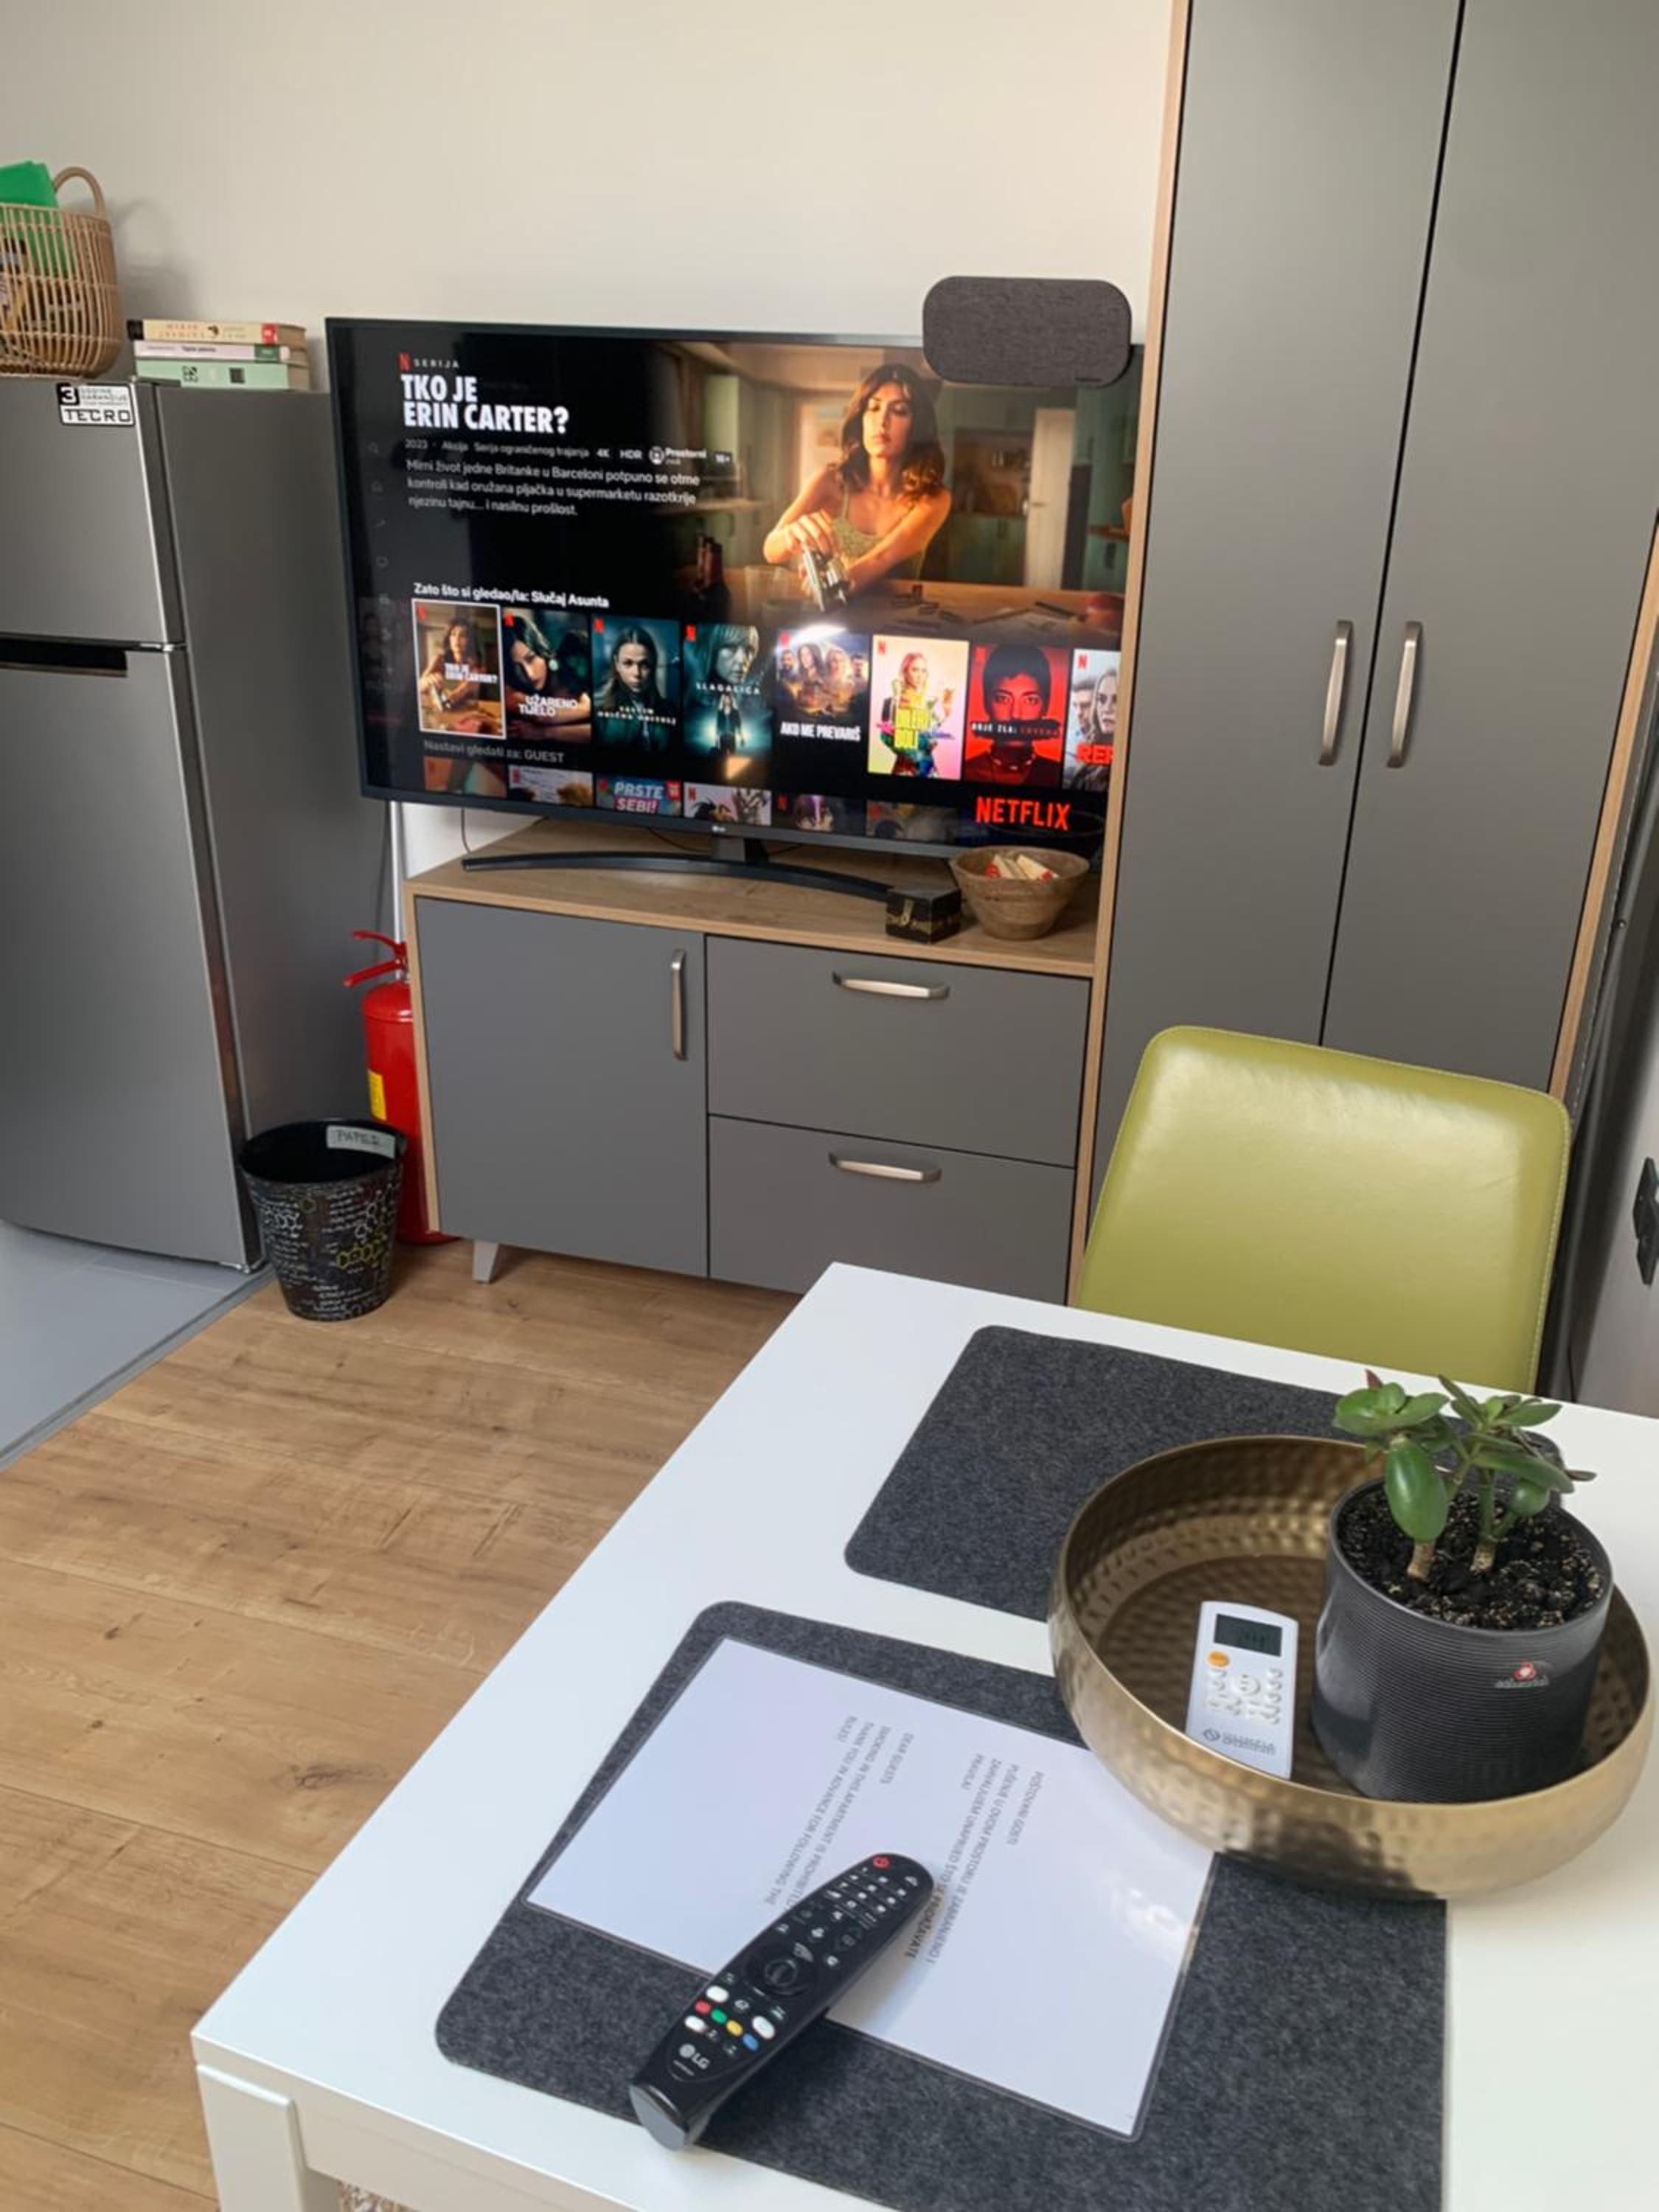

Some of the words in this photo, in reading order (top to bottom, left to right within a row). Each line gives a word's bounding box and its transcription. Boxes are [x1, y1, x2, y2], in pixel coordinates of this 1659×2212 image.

[413, 358, 459, 367] SERIJA
[60, 386, 77, 403] 3
[401, 374, 447, 401] TKO
[453, 376, 478, 402] JE
[64, 408, 131, 422] TECRO
[404, 402, 459, 428] ERIN
[464, 403, 569, 434] CARTER?
[620, 449, 643, 459] HDR
[463, 462, 493, 476] jedne
[495, 463, 540, 477] Britanke
[542, 469, 550, 478] u
[552, 466, 603, 480] Barceloni
[605, 470, 653, 484] potpuno
[655, 473, 668, 484] se
[566, 487, 641, 501] supermarketu
[413, 582, 439, 594] Zato
[442, 583, 459, 597] što
[461, 585, 470, 598] si
[473, 586, 529, 603] gledao/la:
[530, 591, 566, 608] Slučaj
[568, 594, 610, 608] Asunta
[424, 740, 465, 754] Nastavi
[524, 748, 565, 763] GUEST
[616, 797, 656, 814] SEBI!
[975, 796, 1071, 832] NETFLIX
[895, 1731, 915, 1755] DEAR
[879, 1753, 904, 1785] GUESTS
[819, 1790, 856, 1844] APARTMENT
[773, 1832, 813, 1887] FOLLOWING
[692, 2052, 710, 2070] LG
